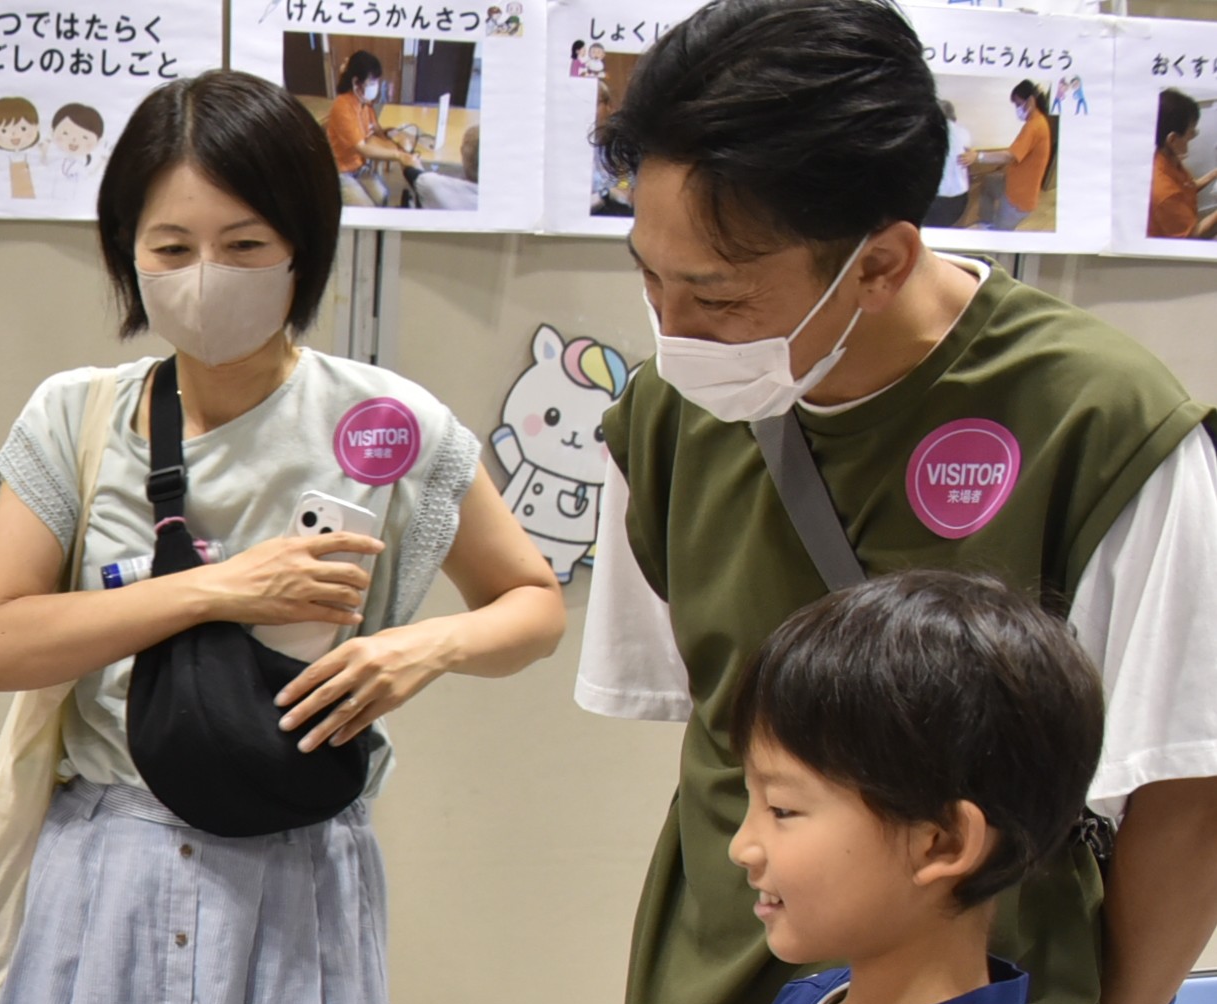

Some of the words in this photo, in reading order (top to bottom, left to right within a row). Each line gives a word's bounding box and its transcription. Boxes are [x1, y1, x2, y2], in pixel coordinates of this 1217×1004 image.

[285, 0, 481, 31] けんこうかんさつ
[347, 428, 409, 447] VISITOR
[926, 463, 1006, 486] VISITOR
[947, 489, 982, 503] 来場者
